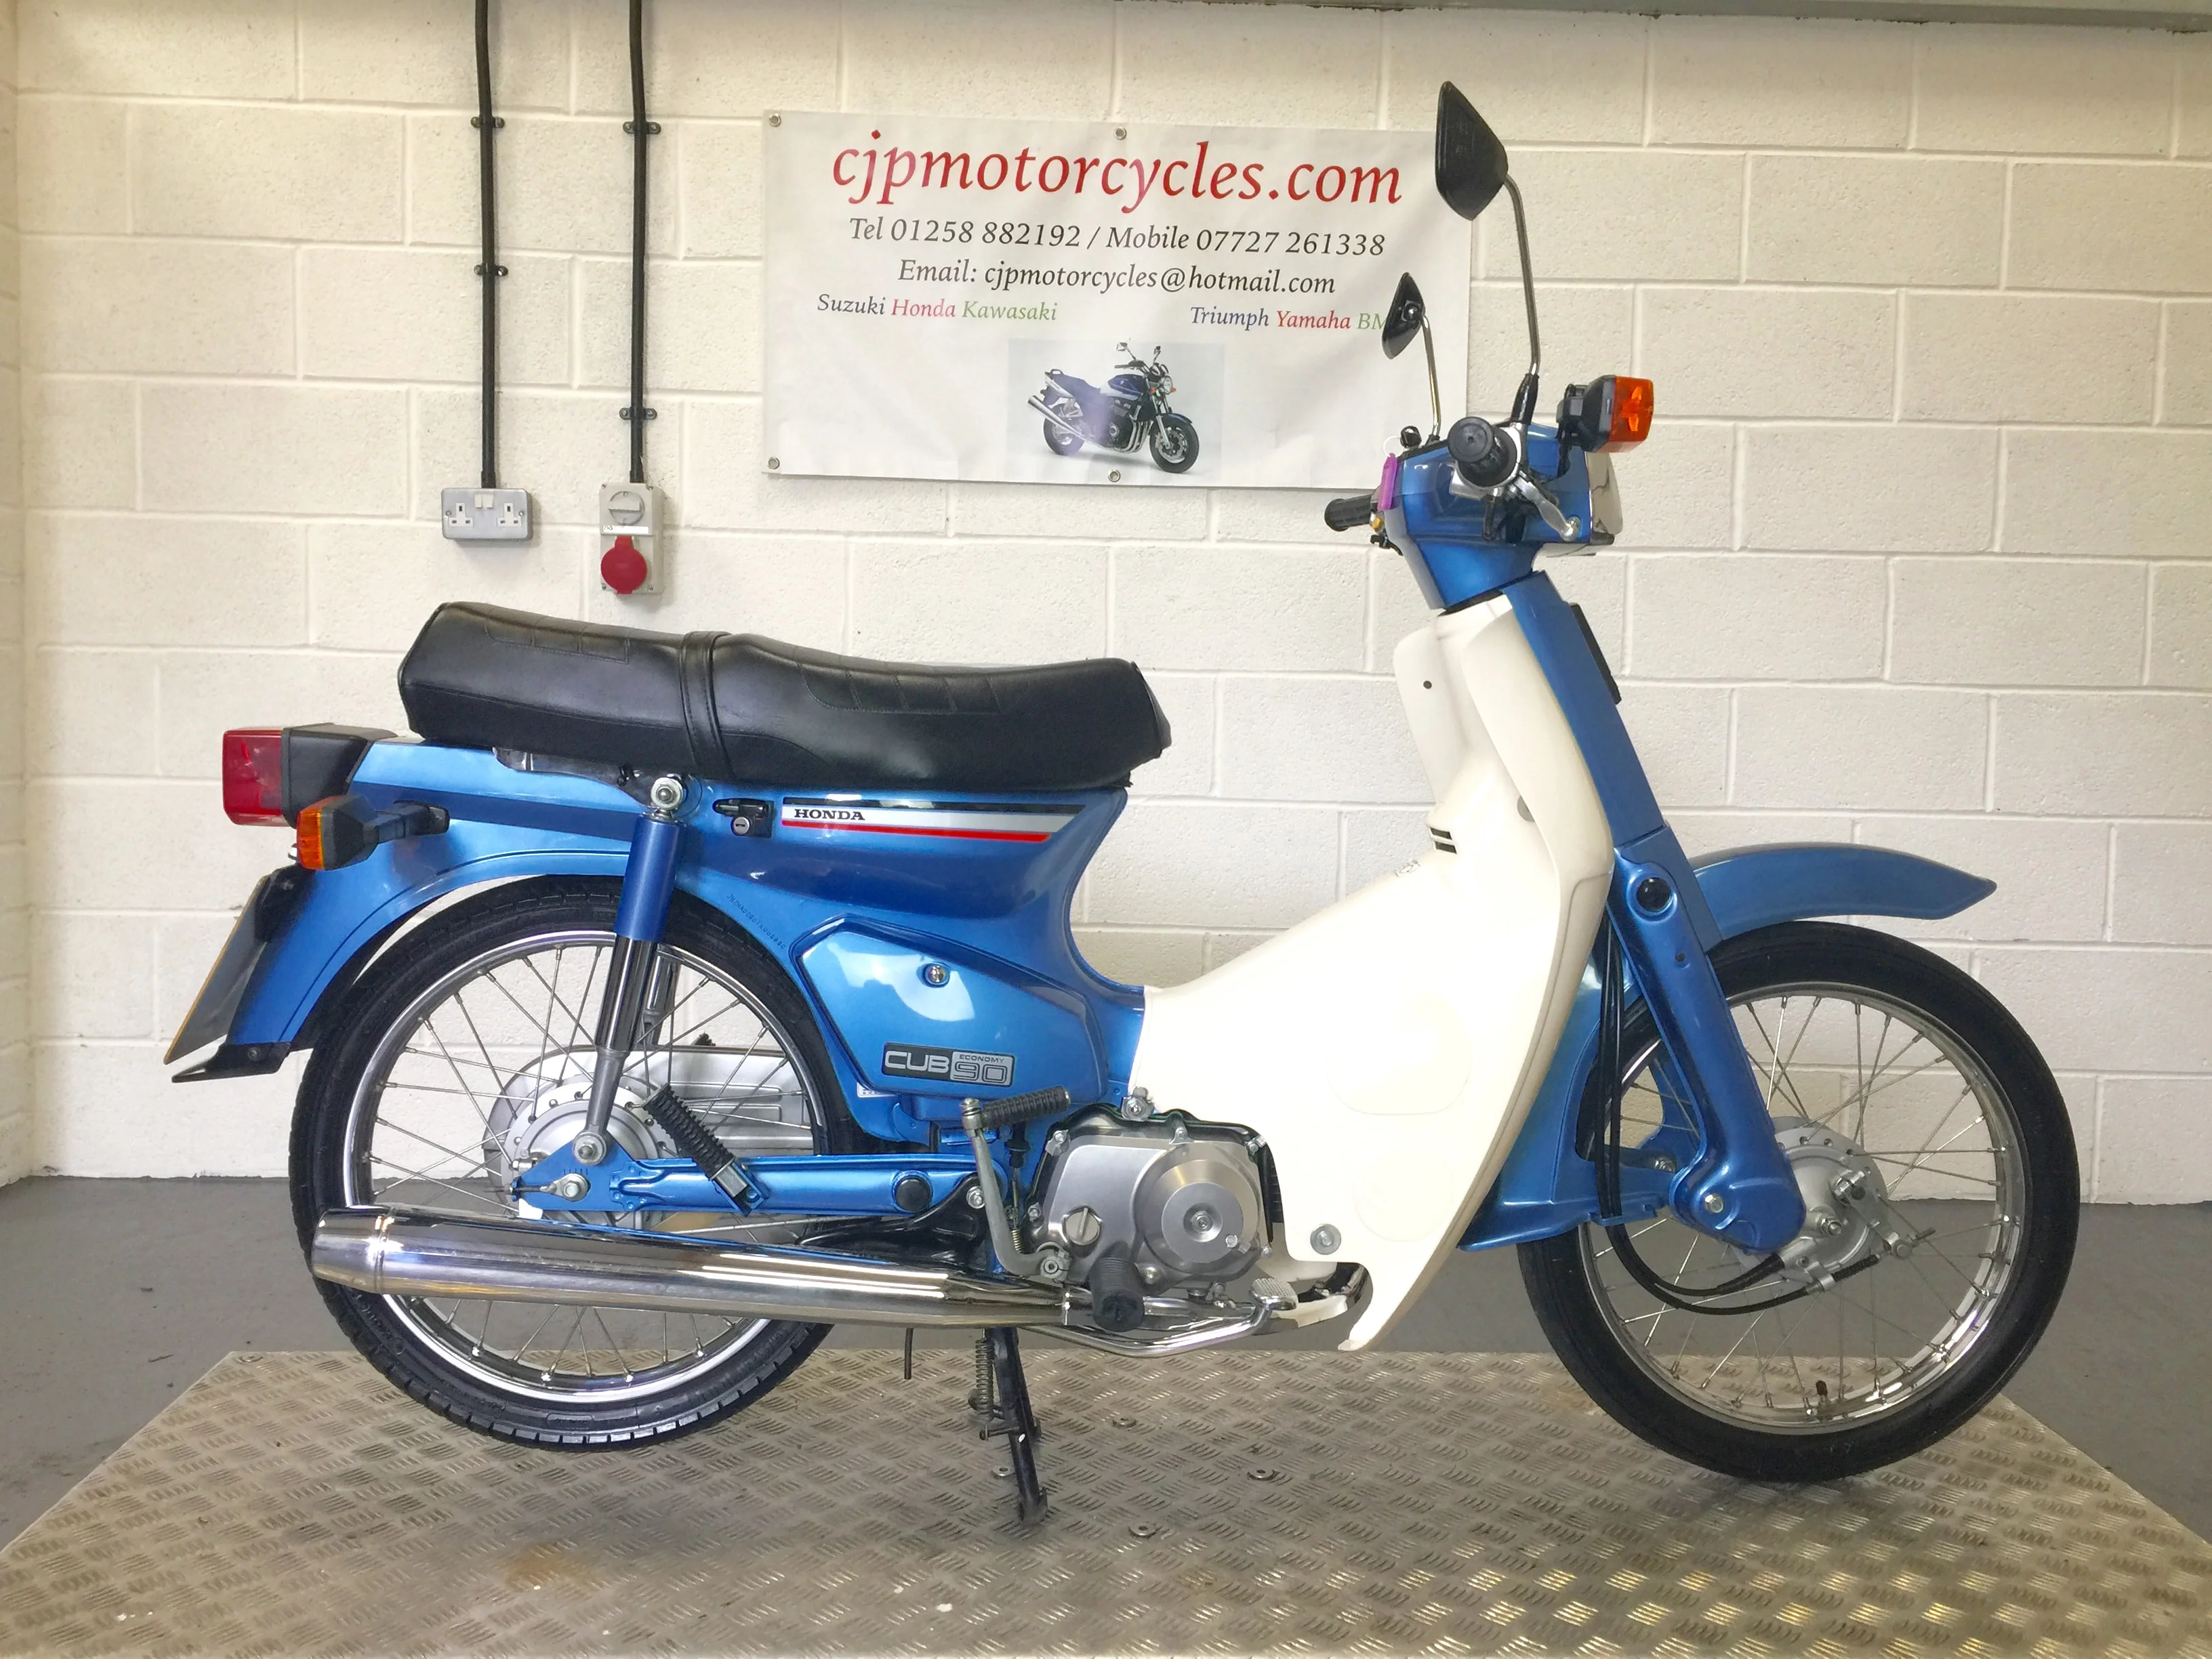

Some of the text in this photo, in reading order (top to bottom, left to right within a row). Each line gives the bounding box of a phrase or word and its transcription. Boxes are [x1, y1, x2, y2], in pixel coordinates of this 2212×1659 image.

[833, 129, 1401, 213] cjpmotorcycles.com
[850, 216, 1386, 256] Tel 01258 882192 / Mobile 07727 261338
[898, 259, 1335, 293] Email: cjpmotorcycles@hotmail.com
[817, 293, 1058, 321] Suzuki Honda Kawasaki
[1191, 306, 1387, 331] Triumph Yamaha BM
[794, 808, 865, 821] HONDA
[884, 1050, 1007, 1084] CUB 90
[959, 1054, 1005, 1063] ECONOMY
